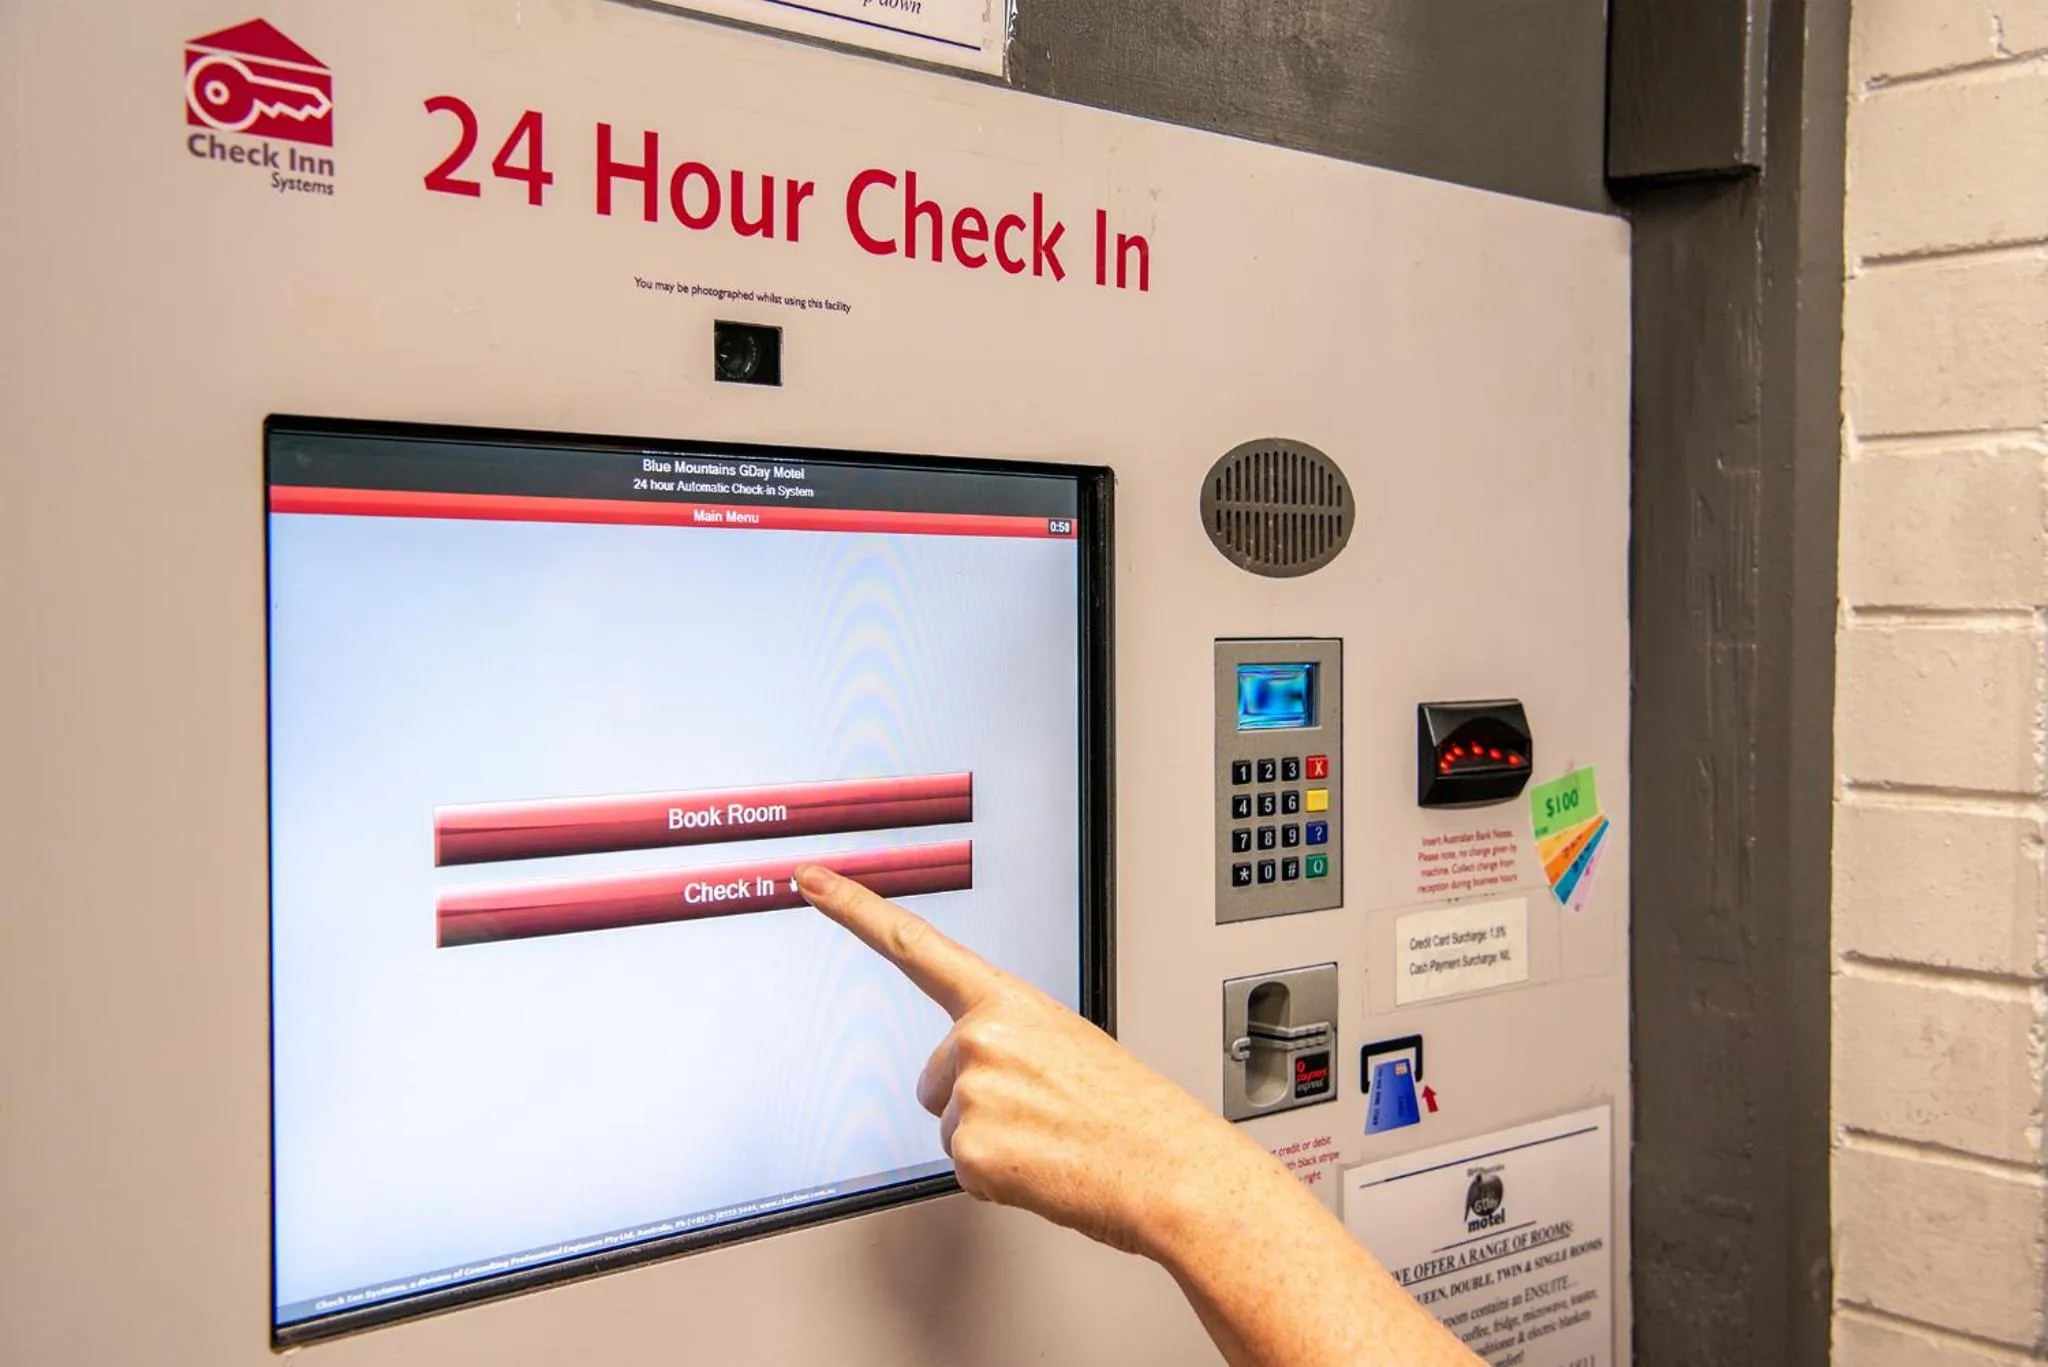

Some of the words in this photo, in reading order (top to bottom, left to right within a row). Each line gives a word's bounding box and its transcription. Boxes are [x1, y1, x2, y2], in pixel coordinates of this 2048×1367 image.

[187, 133, 280, 169] Check
[289, 148, 334, 177] Inn
[271, 172, 334, 195] Systems
[424, 95, 553, 206] 24
[596, 122, 815, 242] Hour
[846, 168, 1065, 281] Check
[1096, 209, 1149, 291] In
[634, 276, 652, 290] You
[655, 281, 674, 294] may
[677, 281, 689, 293] be
[691, 285, 754, 301] photographed
[756, 291, 782, 304] whilst
[784, 296, 806, 309] using
[808, 298, 823, 309] this
[825, 300, 851, 314] facility
[642, 458, 671, 473] Blue
[675, 461, 736, 477] Mountains
[739, 465, 770, 481] GDay
[774, 467, 805, 480] Motel
[633, 478, 648, 491] 24
[651, 478, 674, 491] hour
[677, 480, 729, 495] Automatic
[732, 483, 775, 496] Check-in
[778, 485, 814, 500] System
[693, 509, 722, 523] Main
[726, 510, 760, 523] Menu
[1240, 766, 1246, 780] 1
[1265, 764, 1273, 779] 2
[1289, 762, 1297, 777] 3
[1314, 760, 1324, 776] X
[1239, 799, 1247, 814] 4
[1265, 797, 1272, 812] 5
[1288, 795, 1296, 810] 6
[1545, 789, 1579, 818] $100
[668, 806, 722, 830] Book
[728, 804, 787, 825] Room
[1240, 833, 1248, 849] 7
[1265, 831, 1272, 846] 8
[1289, 828, 1296, 843] 9
[1315, 826, 1323, 841] ?
[1264, 865, 1272, 879] 0
[684, 878, 750, 904] Check
[756, 876, 774, 896] In
[1409, 937, 1432, 951] Credit
[1432, 934, 1450, 947] Card
[1429, 958, 1460, 973] Payment
[1279, 1142, 1300, 1156] credit
[1302, 1141, 1311, 1150] or
[1312, 1136, 1331, 1148] debit
[1468, 1207, 1505, 1233] motel
[1413, 1254, 1455, 1280] OFFER
[1458, 1252, 1466, 1267] A
[1468, 1237, 1510, 1263] RANGE
[1512, 1232, 1528, 1250] OF
[1414, 1287, 1448, 1305] UEEN,
[1497, 1263, 1522, 1282] TWIN
[1535, 1248, 1567, 1271] SINGLE
